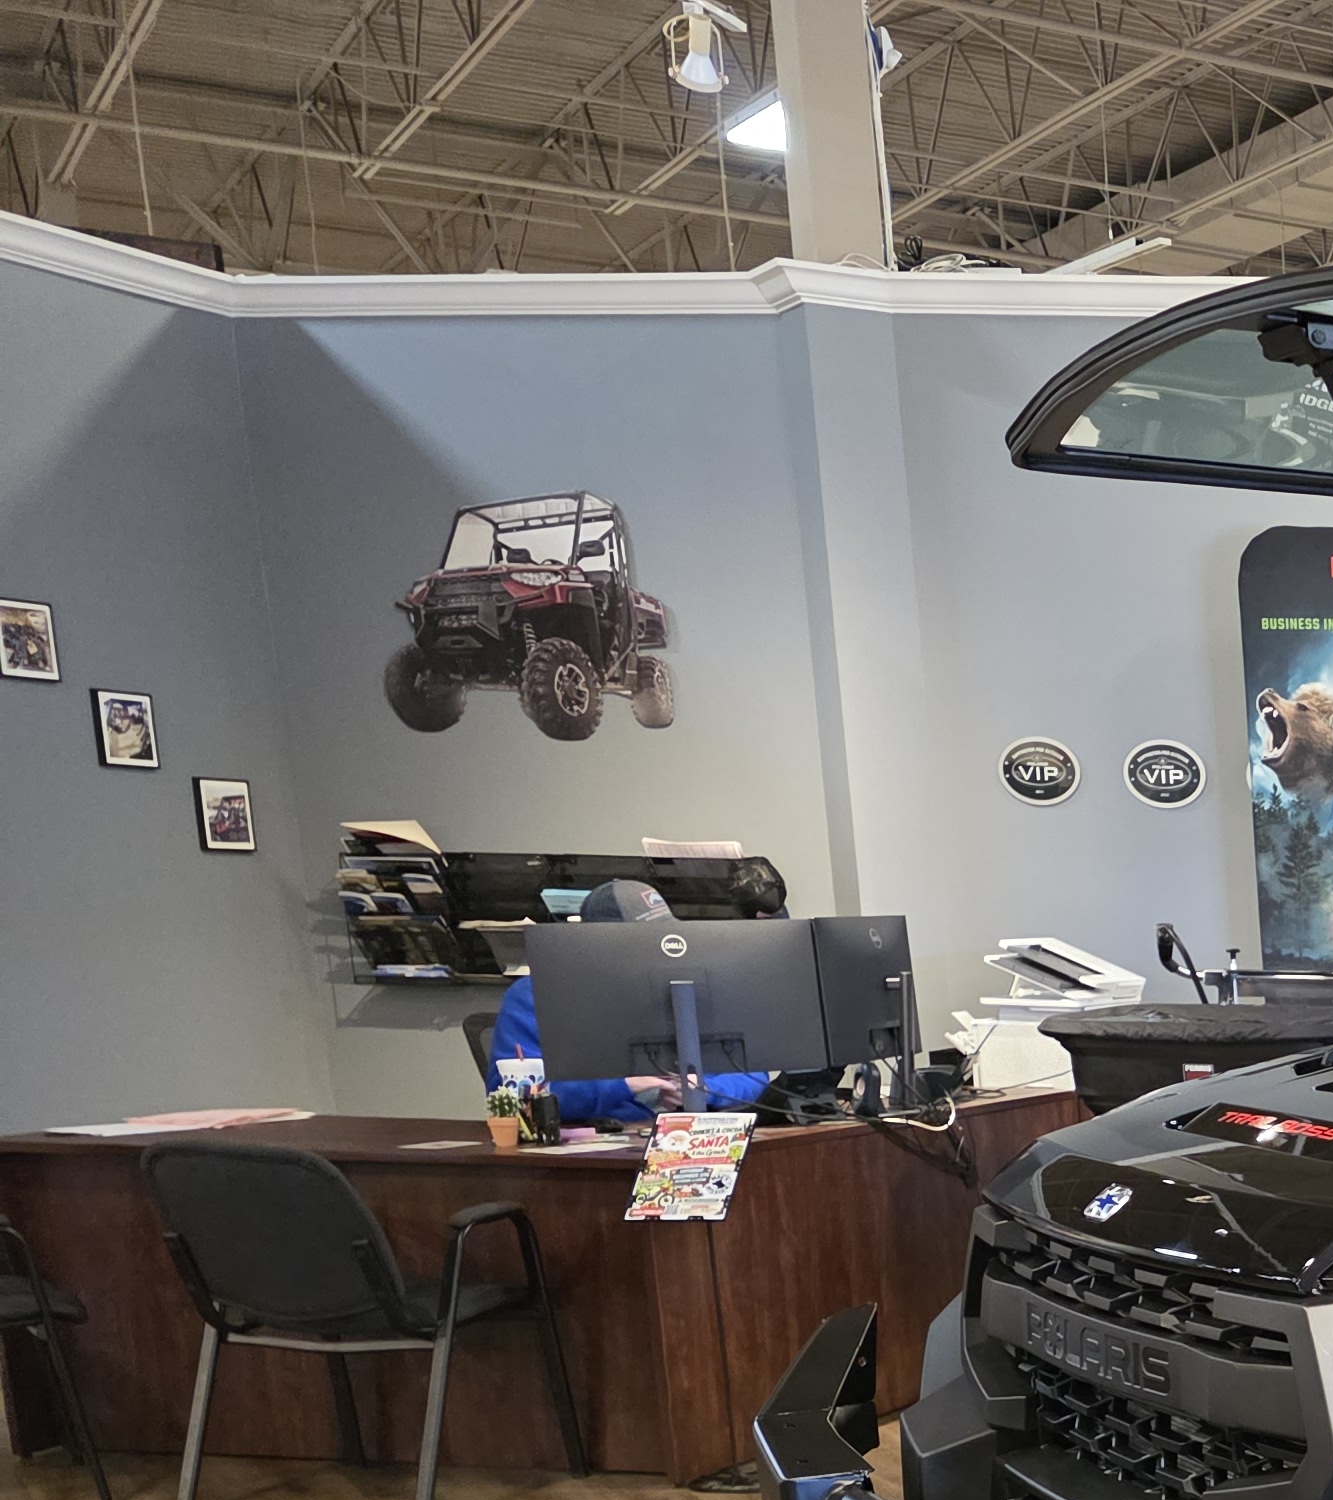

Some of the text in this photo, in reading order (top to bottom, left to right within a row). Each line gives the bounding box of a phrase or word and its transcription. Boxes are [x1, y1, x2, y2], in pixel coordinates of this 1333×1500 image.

[1261, 617, 1320, 630] BUSINESS
[1018, 765, 1059, 781] VIP
[1143, 768, 1185, 785] VIP
[665, 942, 684, 950] DELL
[687, 1135, 729, 1151] SANTA
[1027, 1302, 1171, 1397] POLARIS
